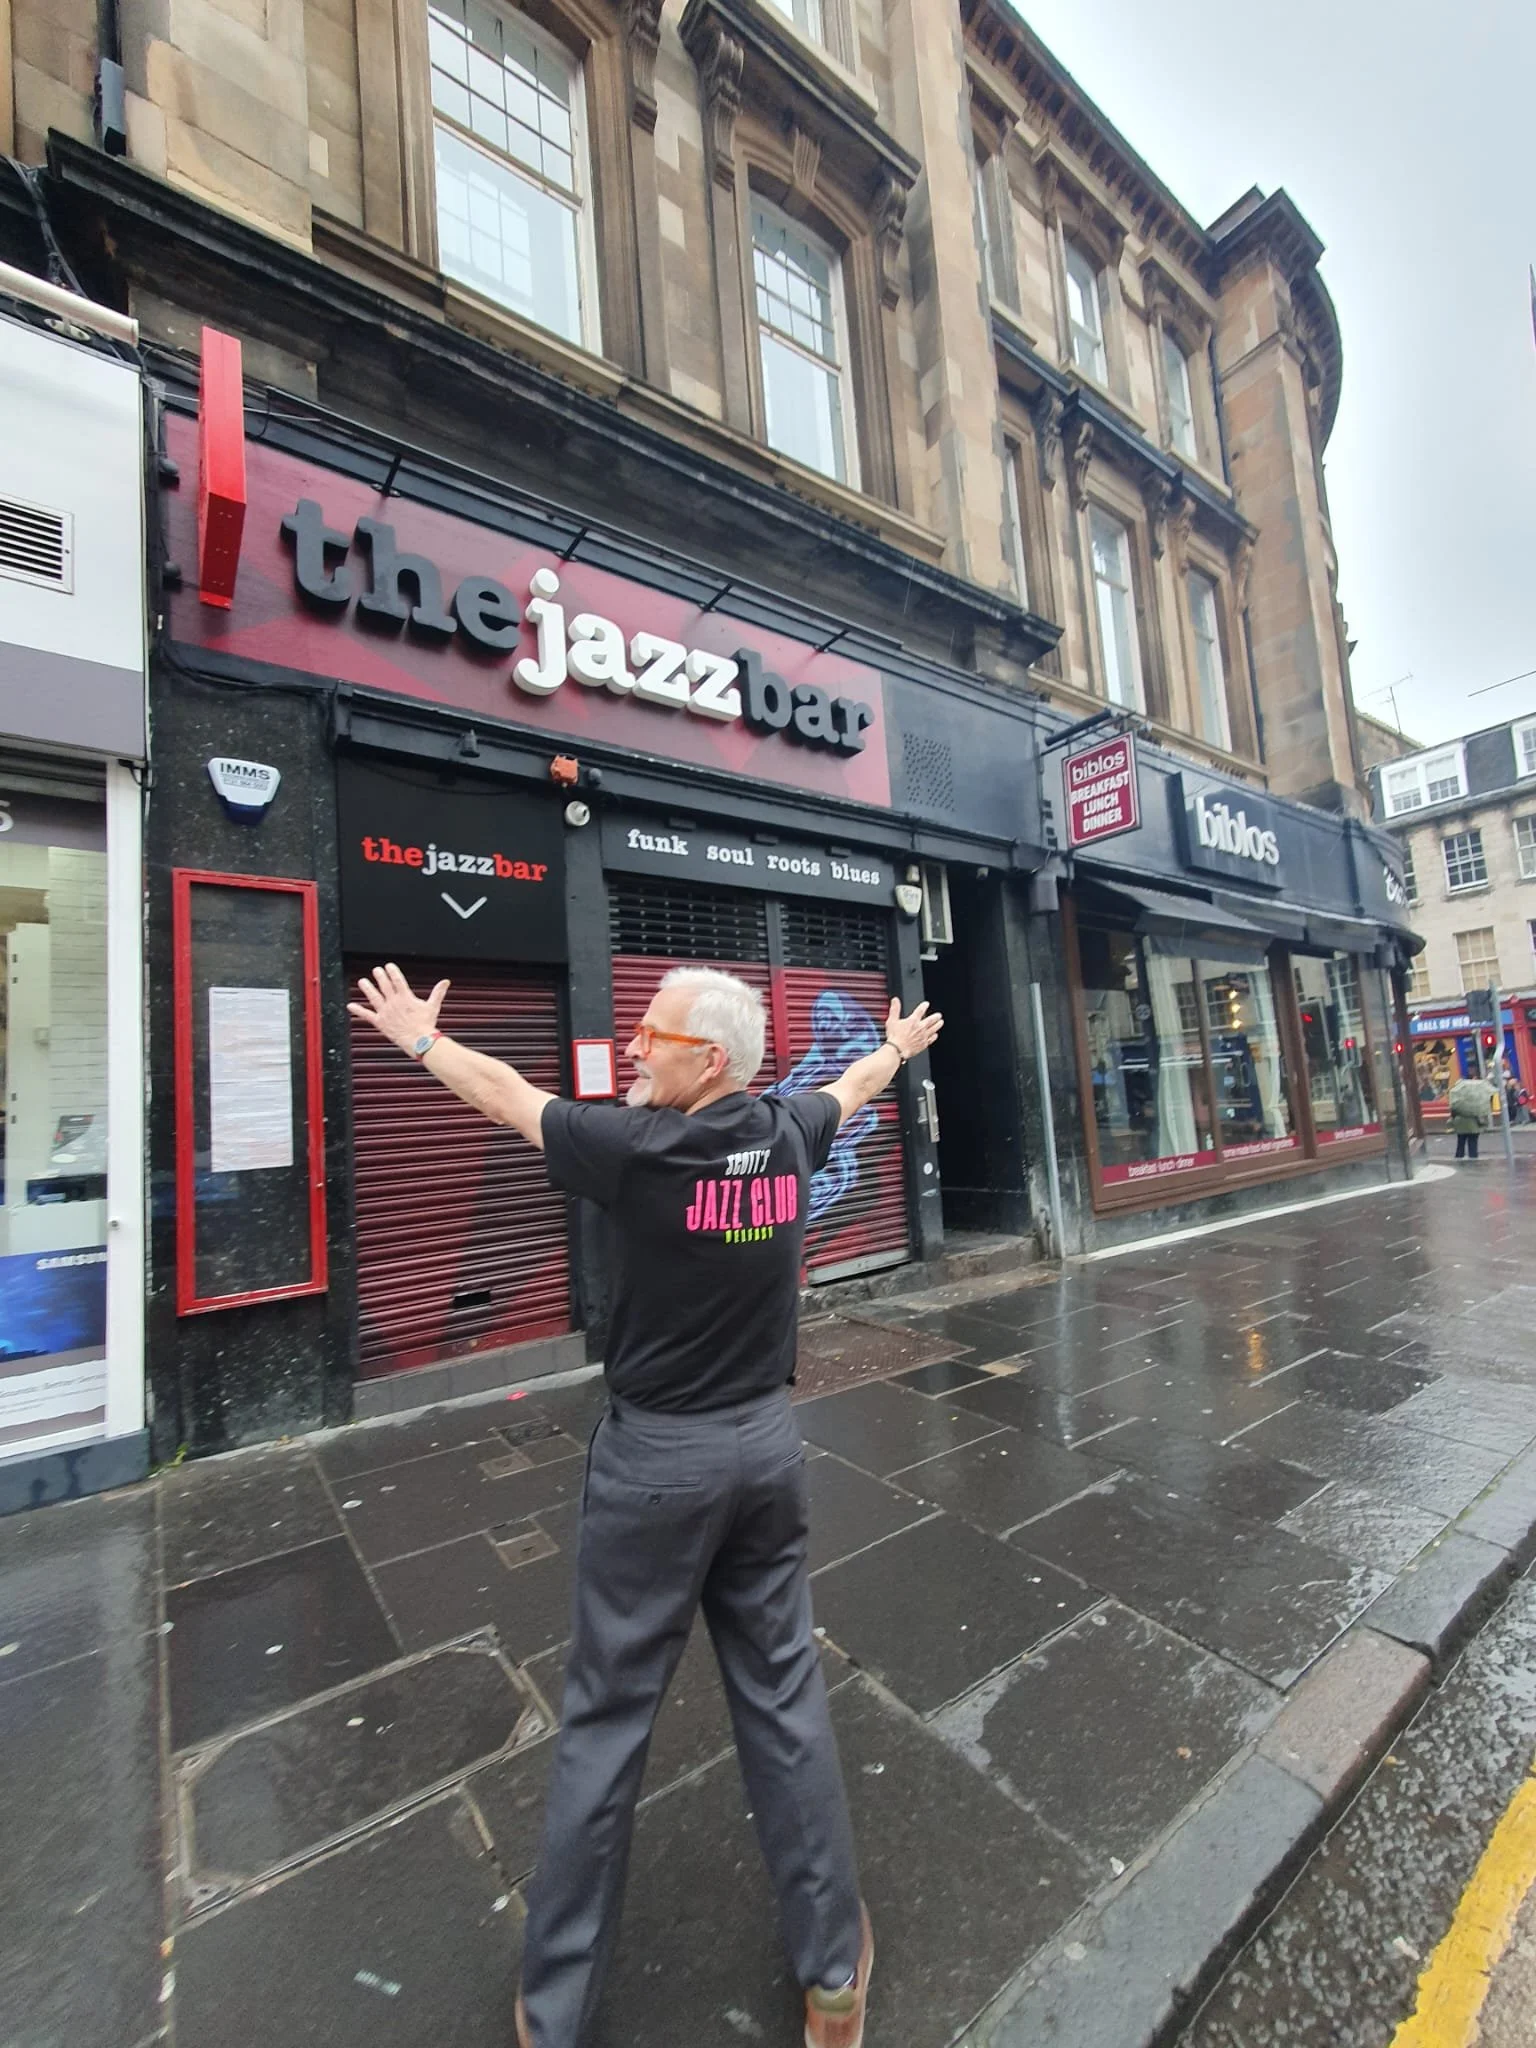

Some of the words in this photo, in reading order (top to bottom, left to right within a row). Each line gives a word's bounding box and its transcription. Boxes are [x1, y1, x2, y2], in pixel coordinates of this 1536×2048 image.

[220, 762, 271, 780] IMMS
[1072, 751, 1126, 783] biblos
[1071, 771, 1129, 805] BREAKFAST
[1083, 791, 1119, 817] LUNCH
[1083, 807, 1123, 833] DINNER
[1196, 797, 1279, 865] biblos
[628, 828, 689, 856] funk
[706, 845, 755, 866] soul
[767, 853, 821, 877] roots
[831, 861, 881, 886] blues
[685, 1179, 743, 1231] JAZZ
[750, 1174, 798, 1228] CLUB
[36, 1251, 107, 1270] SAMSUN
